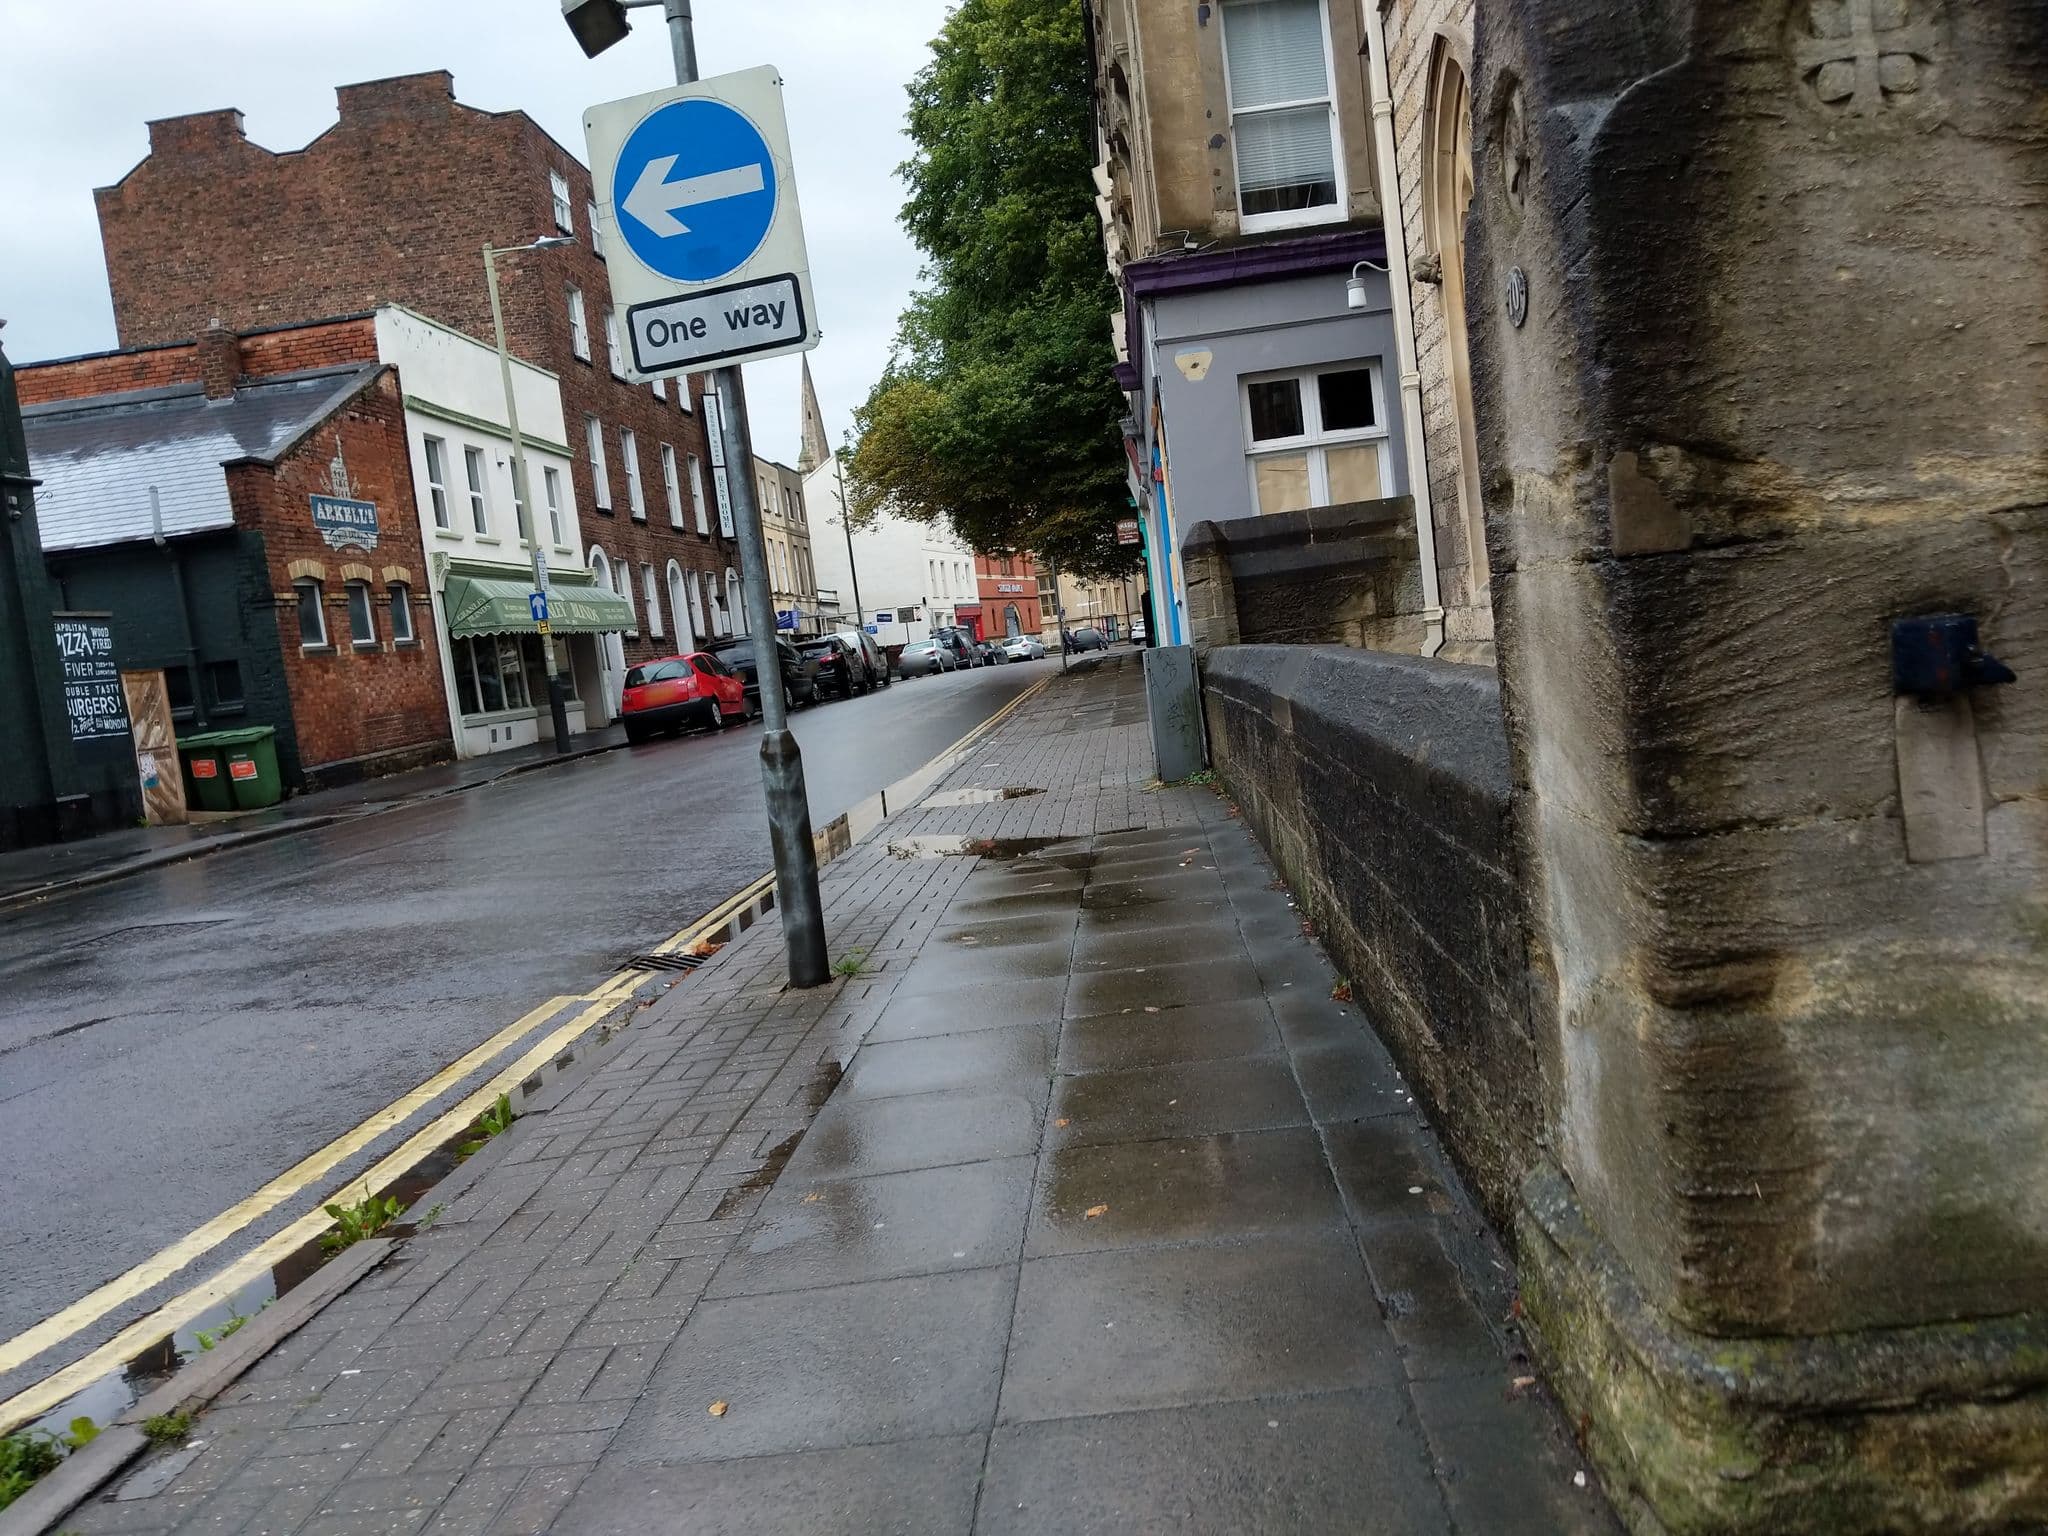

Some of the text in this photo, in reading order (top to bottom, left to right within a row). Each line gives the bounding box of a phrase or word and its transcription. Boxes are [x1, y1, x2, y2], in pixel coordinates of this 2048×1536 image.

[646, 300, 785, 347] One way
[317, 502, 375, 524] ARKELL'S
[720, 503, 730, 528] HOME
[90, 627, 109, 638] WOOD
[91, 637, 112, 650] FIRED
[65, 661, 94, 677] FIVER
[95, 683, 119, 695] TASTY
[103, 717, 127, 730] MONDAY
